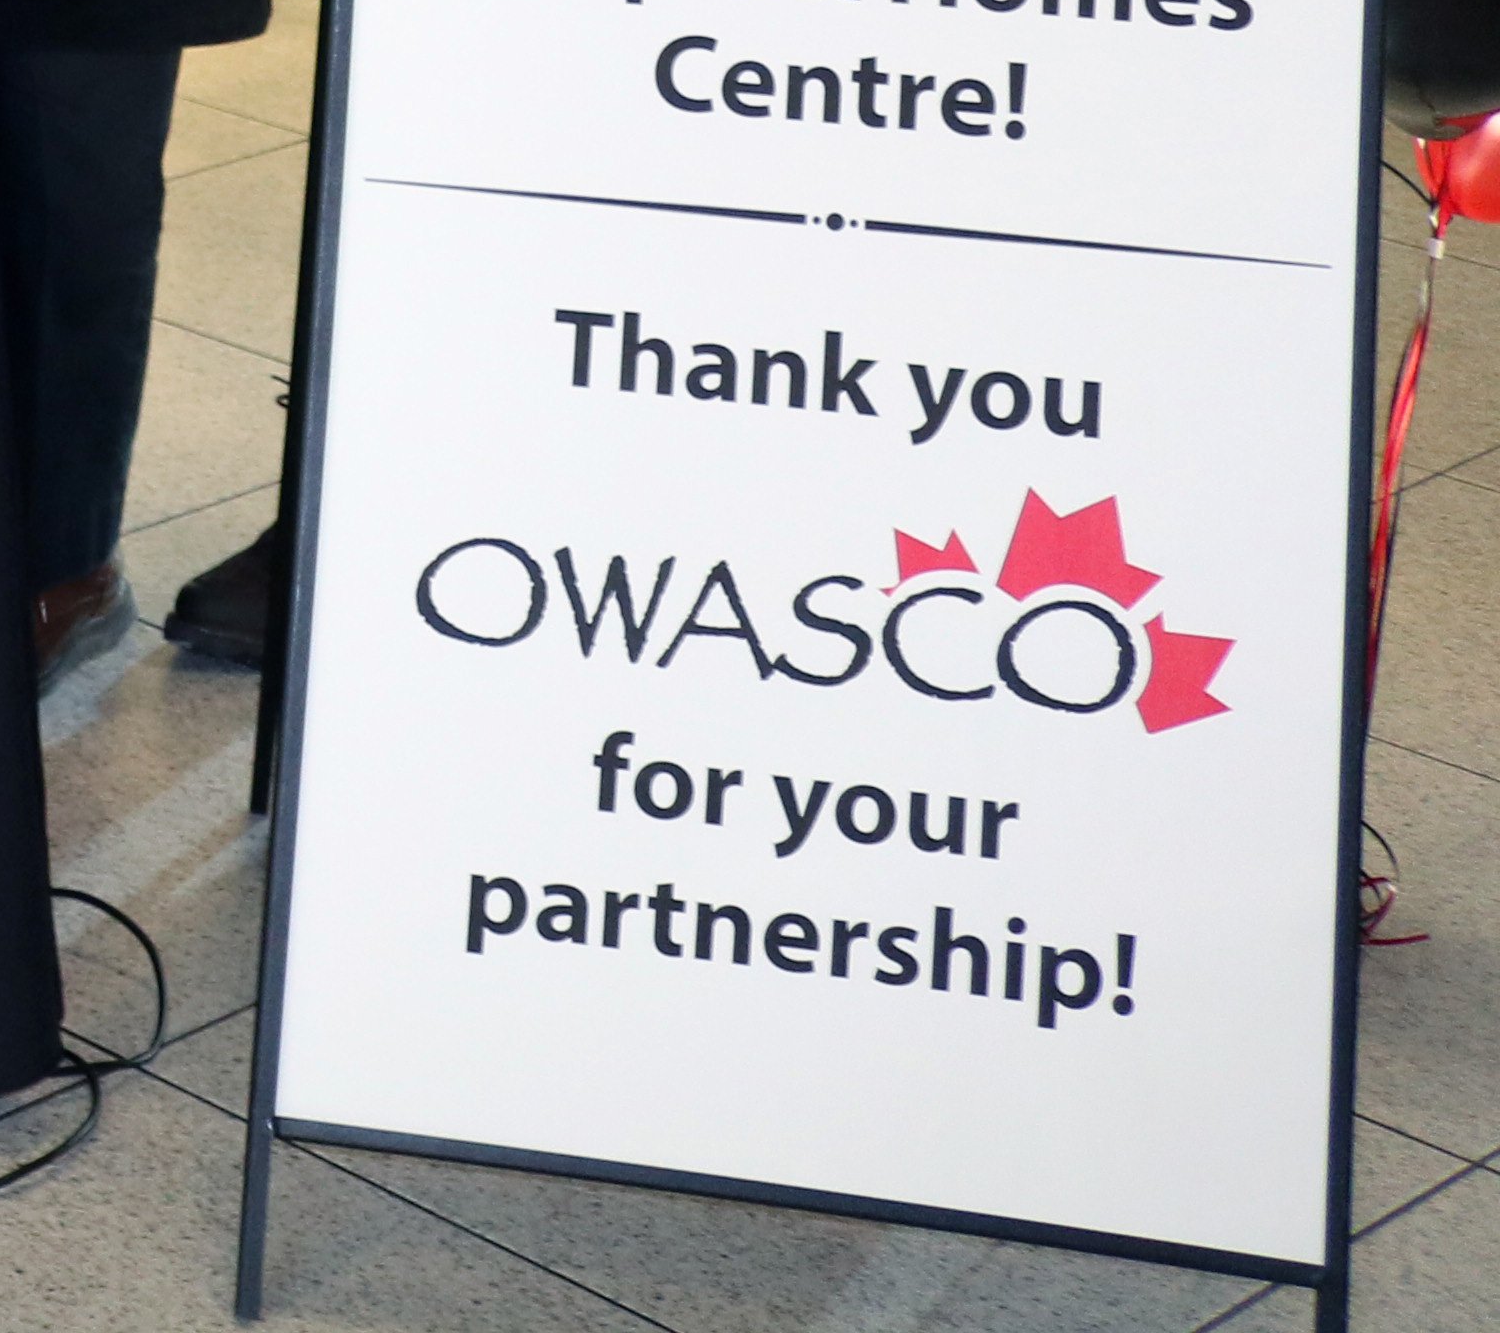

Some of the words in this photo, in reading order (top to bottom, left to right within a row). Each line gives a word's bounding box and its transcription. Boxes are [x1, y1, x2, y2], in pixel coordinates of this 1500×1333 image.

[655, 36, 1026, 140] Centre!
[555, 309, 877, 416] Thank
[908, 364, 1100, 444] you
[415, 538, 1134, 712] OWASCO
[594, 731, 742, 825] for
[773, 775, 1018, 859] your
[467, 874, 1135, 1028] partnership!
